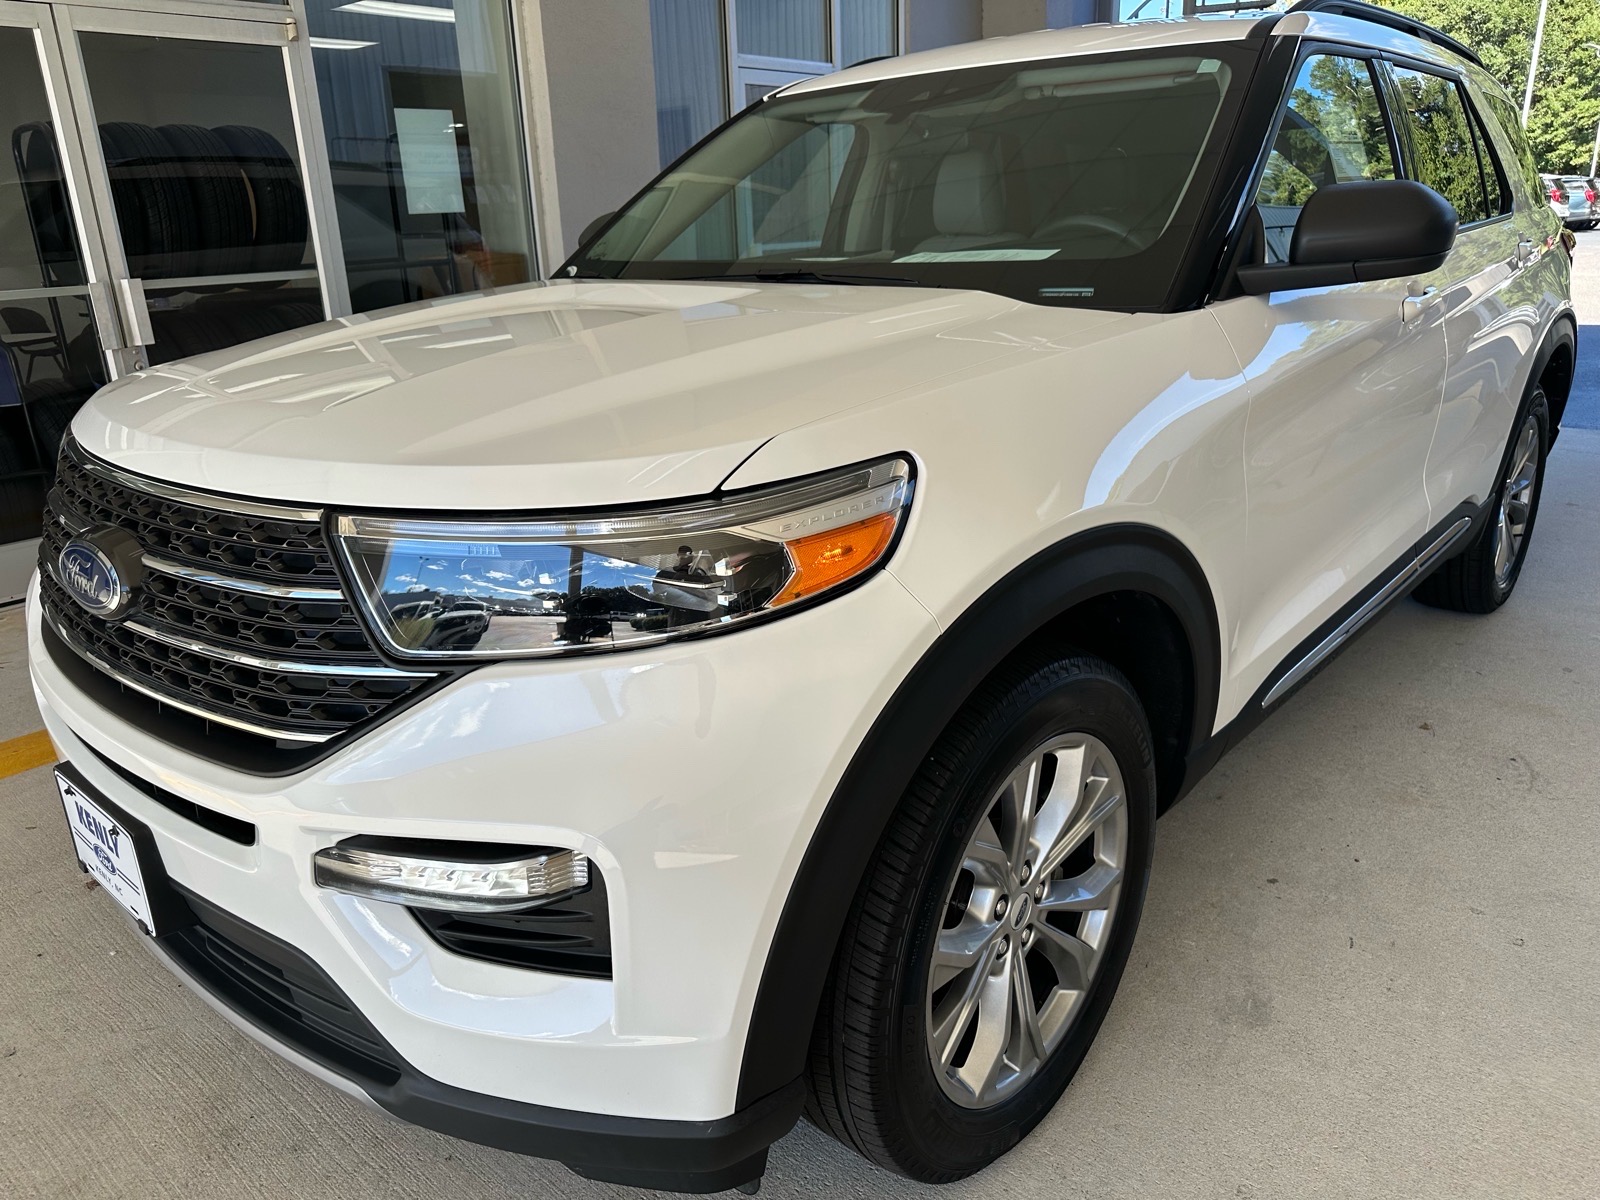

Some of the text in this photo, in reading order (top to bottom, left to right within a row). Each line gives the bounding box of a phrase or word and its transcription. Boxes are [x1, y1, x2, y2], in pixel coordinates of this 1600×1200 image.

[779, 495, 885, 533] EXPLORER
[63, 553, 99, 600] Ford
[75, 801, 120, 859] KENLY
[97, 847, 113, 872] Ford
